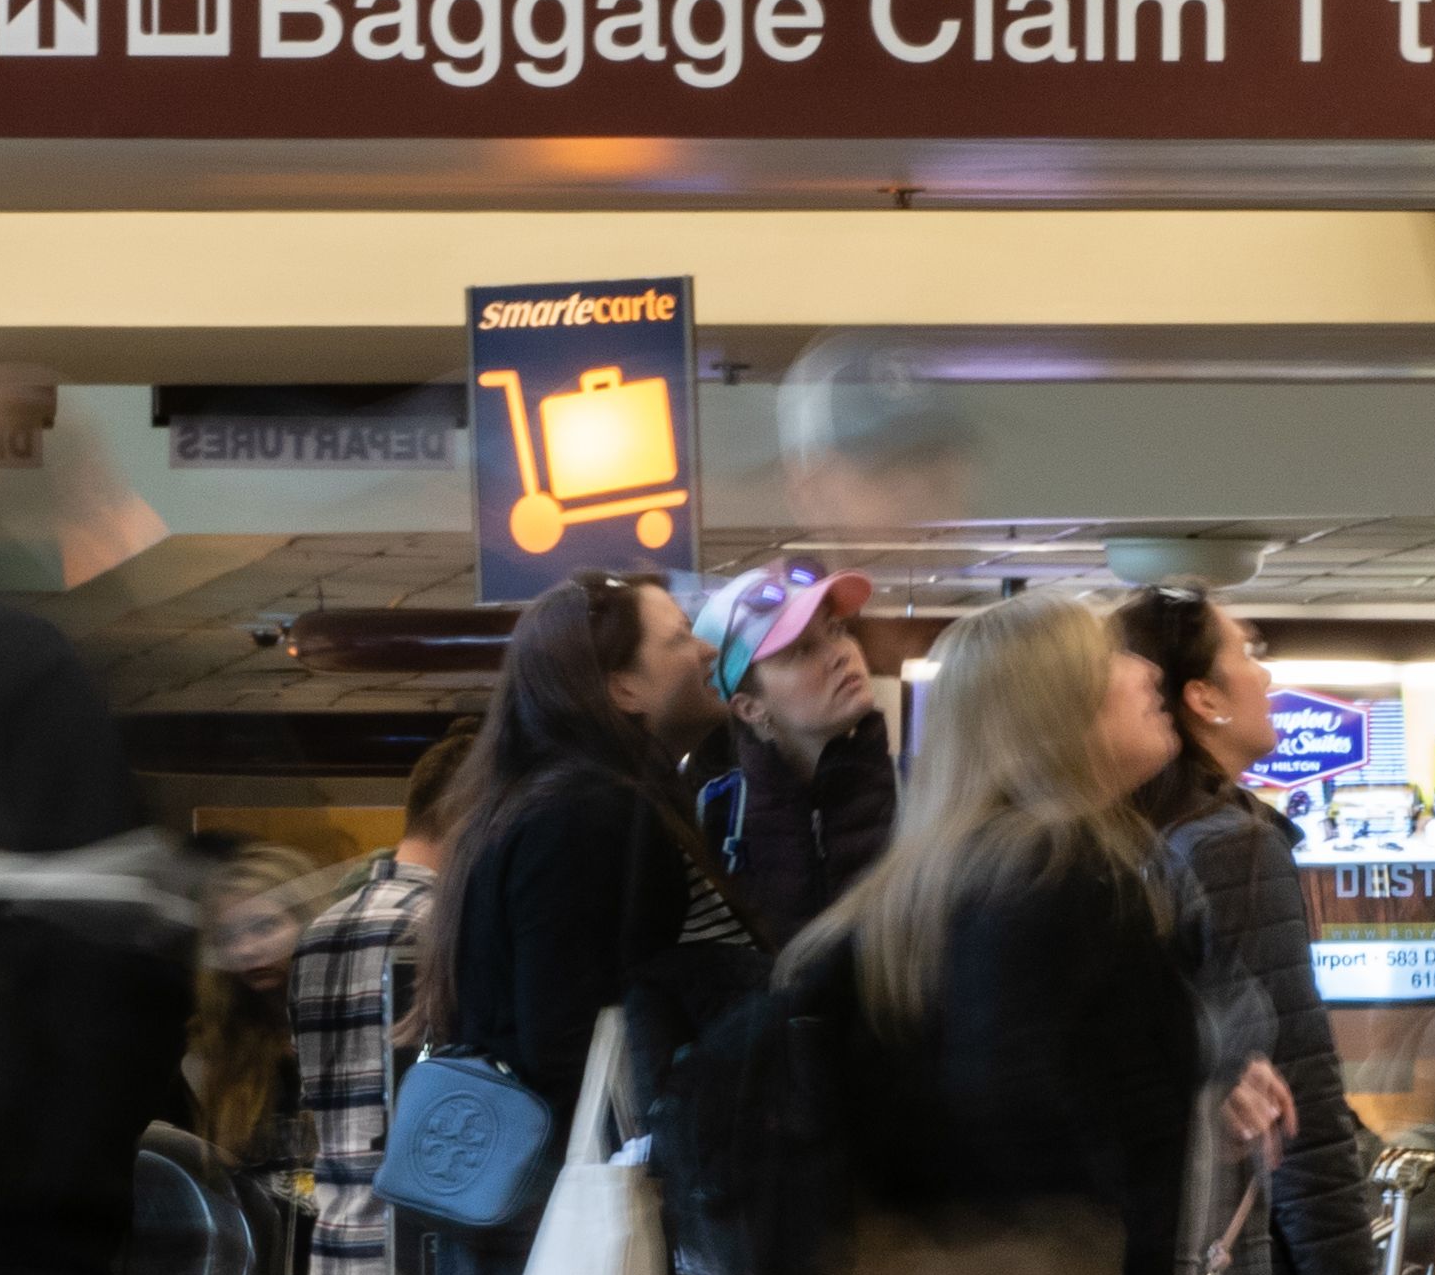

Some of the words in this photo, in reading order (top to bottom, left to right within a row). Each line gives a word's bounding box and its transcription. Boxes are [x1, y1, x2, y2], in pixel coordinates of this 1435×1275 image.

[477, 287, 677, 330] smartecarte
[1271, 761, 1321, 773] HILTON
[1310, 950, 1367, 970] irport
